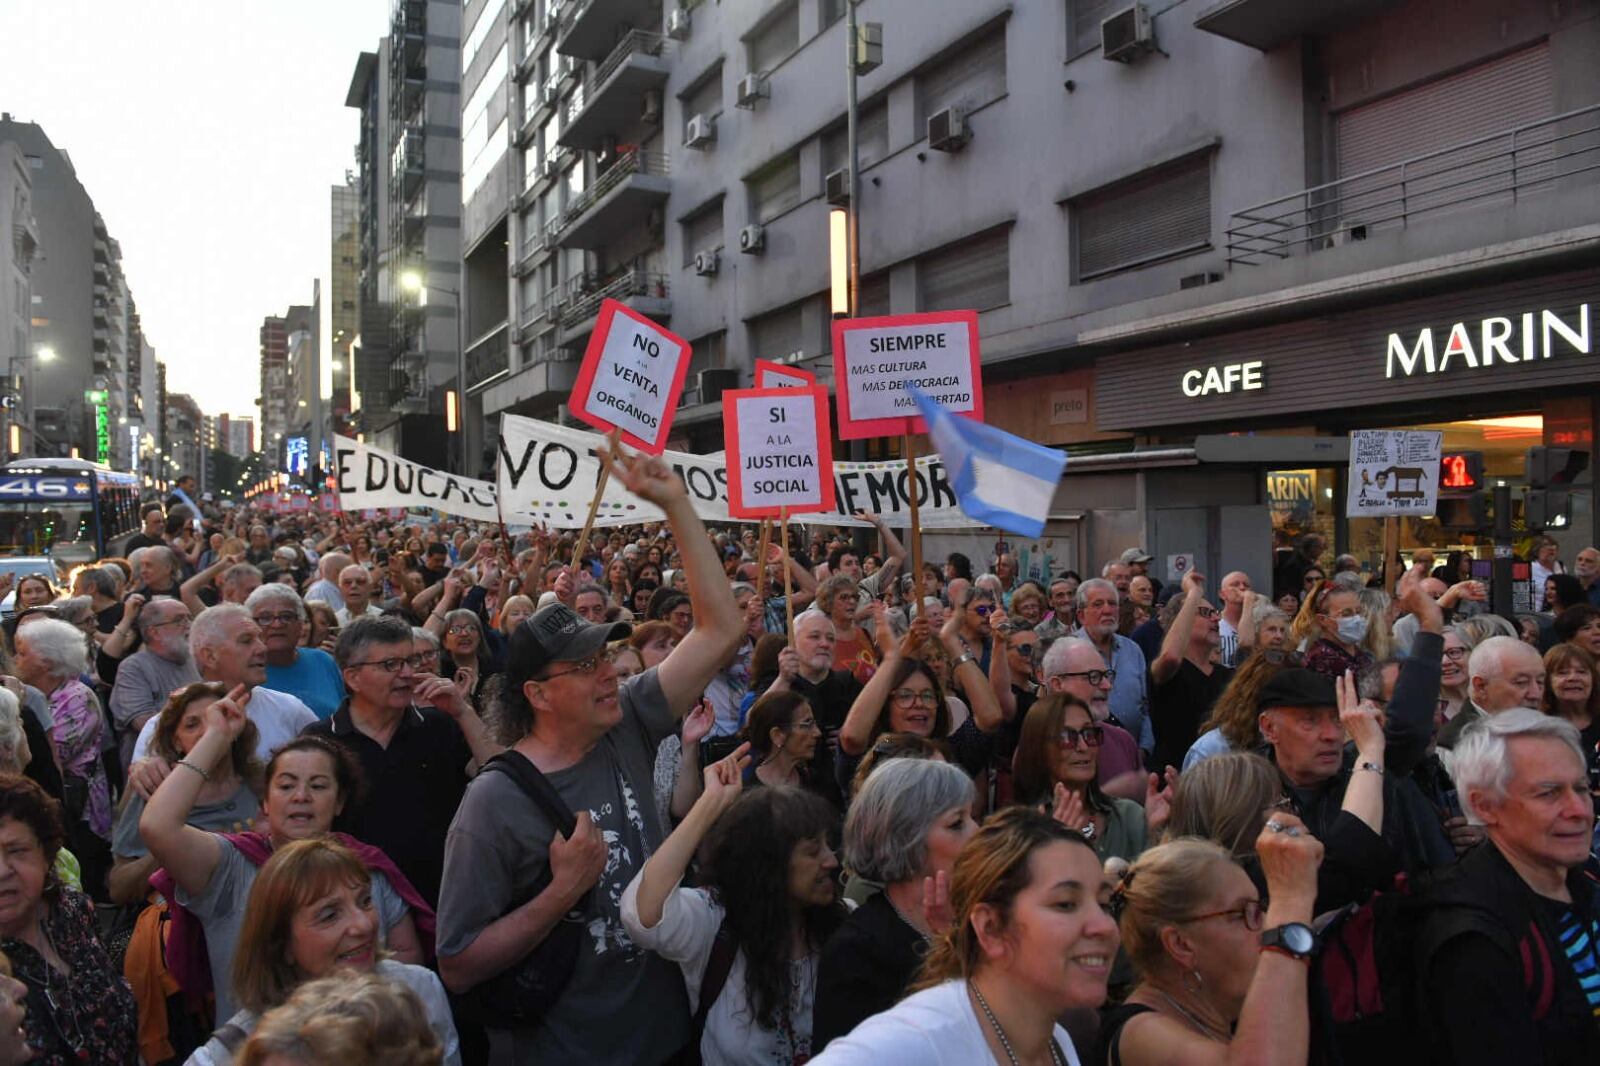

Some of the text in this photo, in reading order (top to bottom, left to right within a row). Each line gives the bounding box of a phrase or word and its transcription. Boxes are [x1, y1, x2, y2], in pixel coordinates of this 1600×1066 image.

[633, 333, 660, 358] NO
[870, 333, 947, 354] SIEMPRE
[1386, 303, 1593, 378] MARIN
[851, 360, 927, 375] MAS CULTURA
[613, 362, 659, 397] VENTA
[862, 376, 960, 392] MAS DEMOCRACIA
[1181, 361, 1263, 397] CAFE
[596, 391, 658, 428] ORGANOS
[769, 406, 786, 423] SI
[766, 434, 792, 445] A LA
[746, 454, 814, 470] JUSTICIA
[753, 479, 810, 494] SOCIAL
